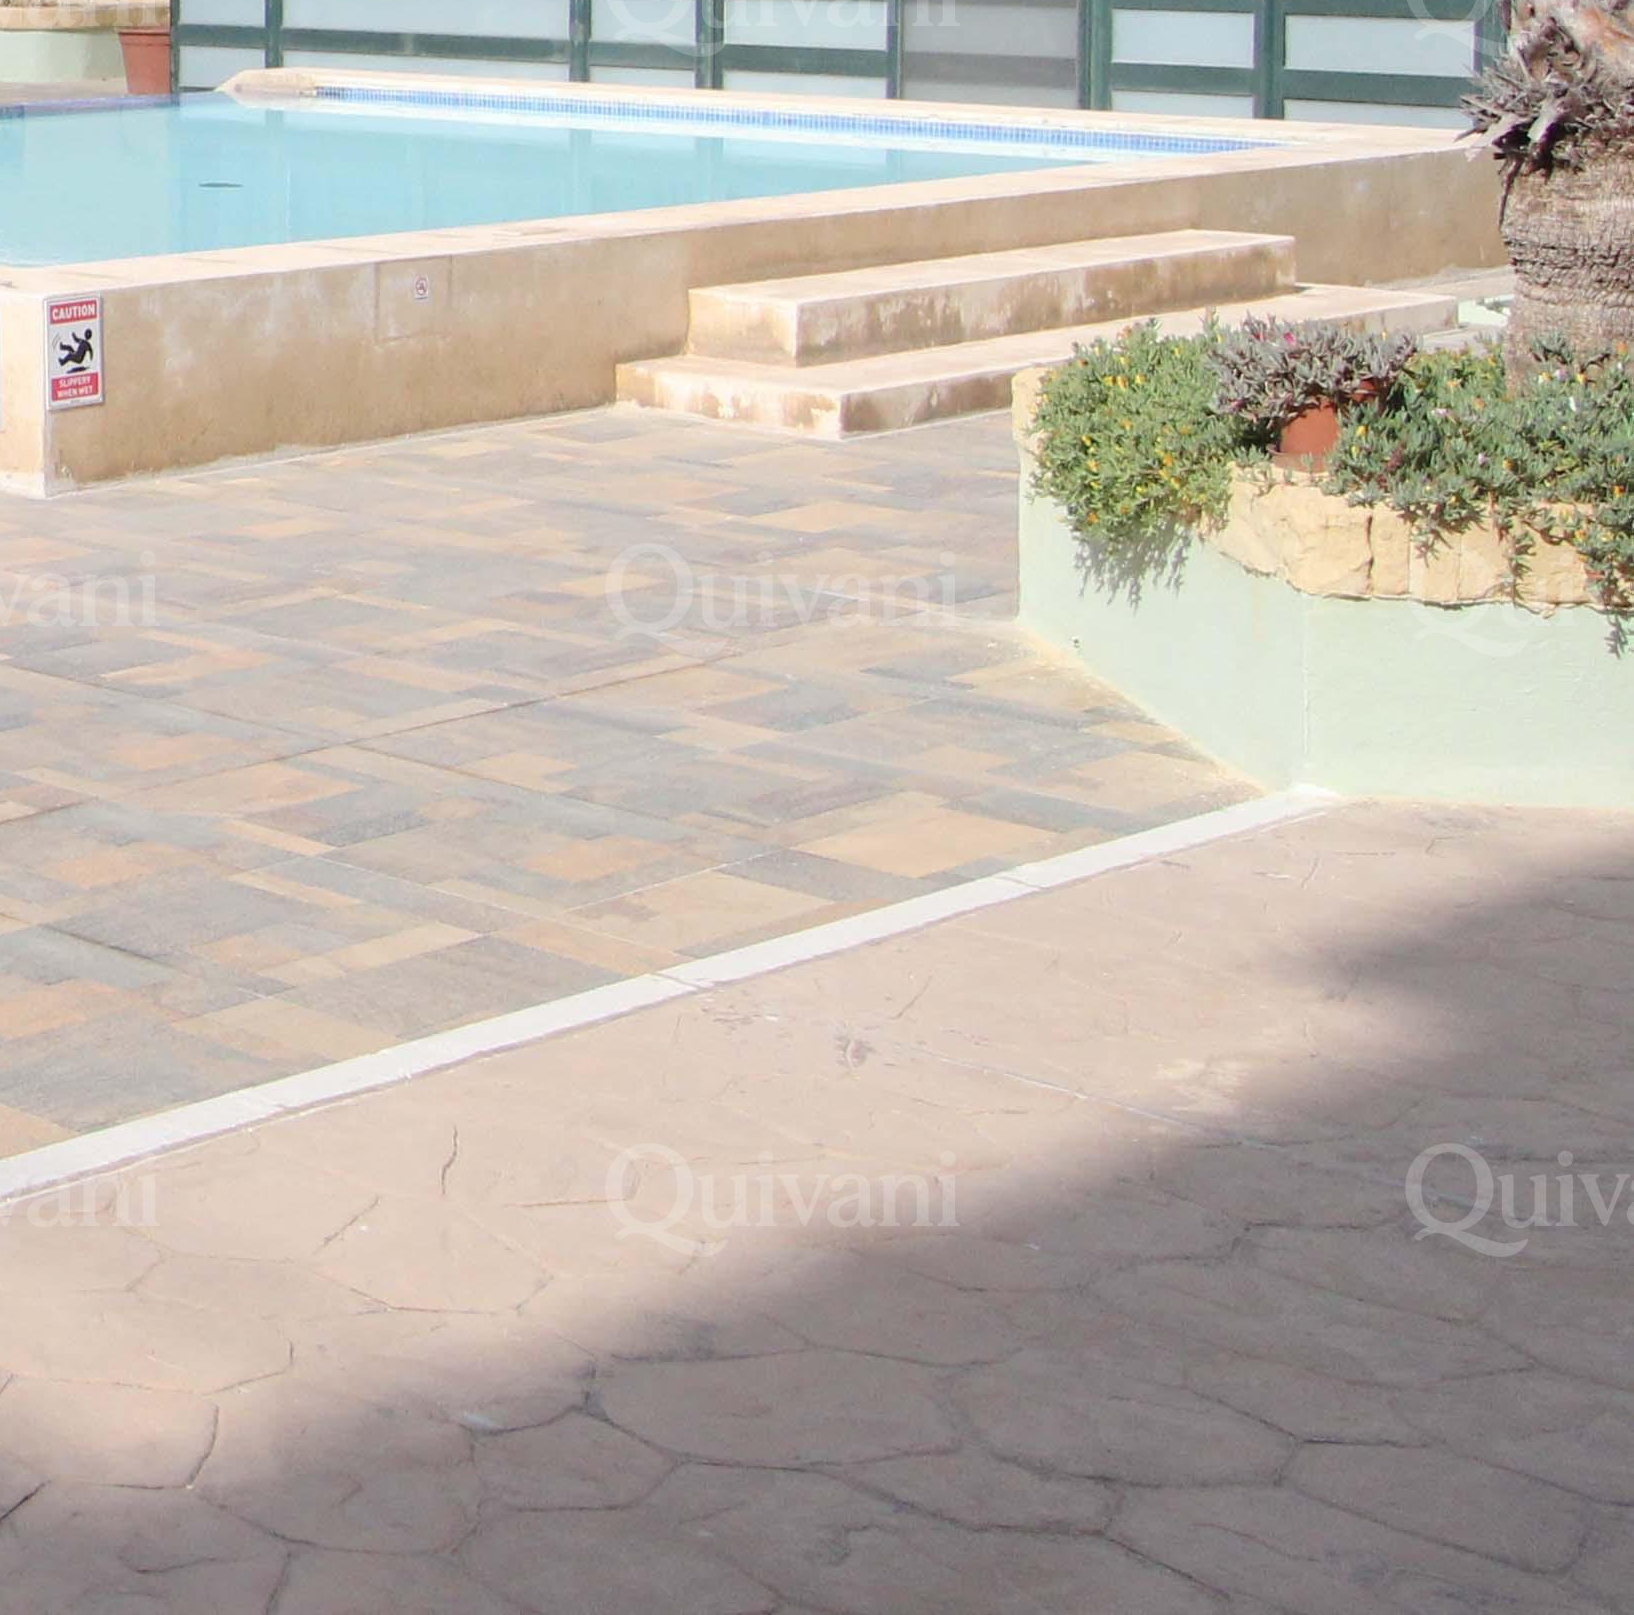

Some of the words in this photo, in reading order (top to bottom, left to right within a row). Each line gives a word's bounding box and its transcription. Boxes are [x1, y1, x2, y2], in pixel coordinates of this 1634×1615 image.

[52, 303, 96, 320] CAUTION
[59, 376, 92, 387] SLIPPERY
[56, 387, 78, 398] WHEN
[79, 385, 93, 396] WET
